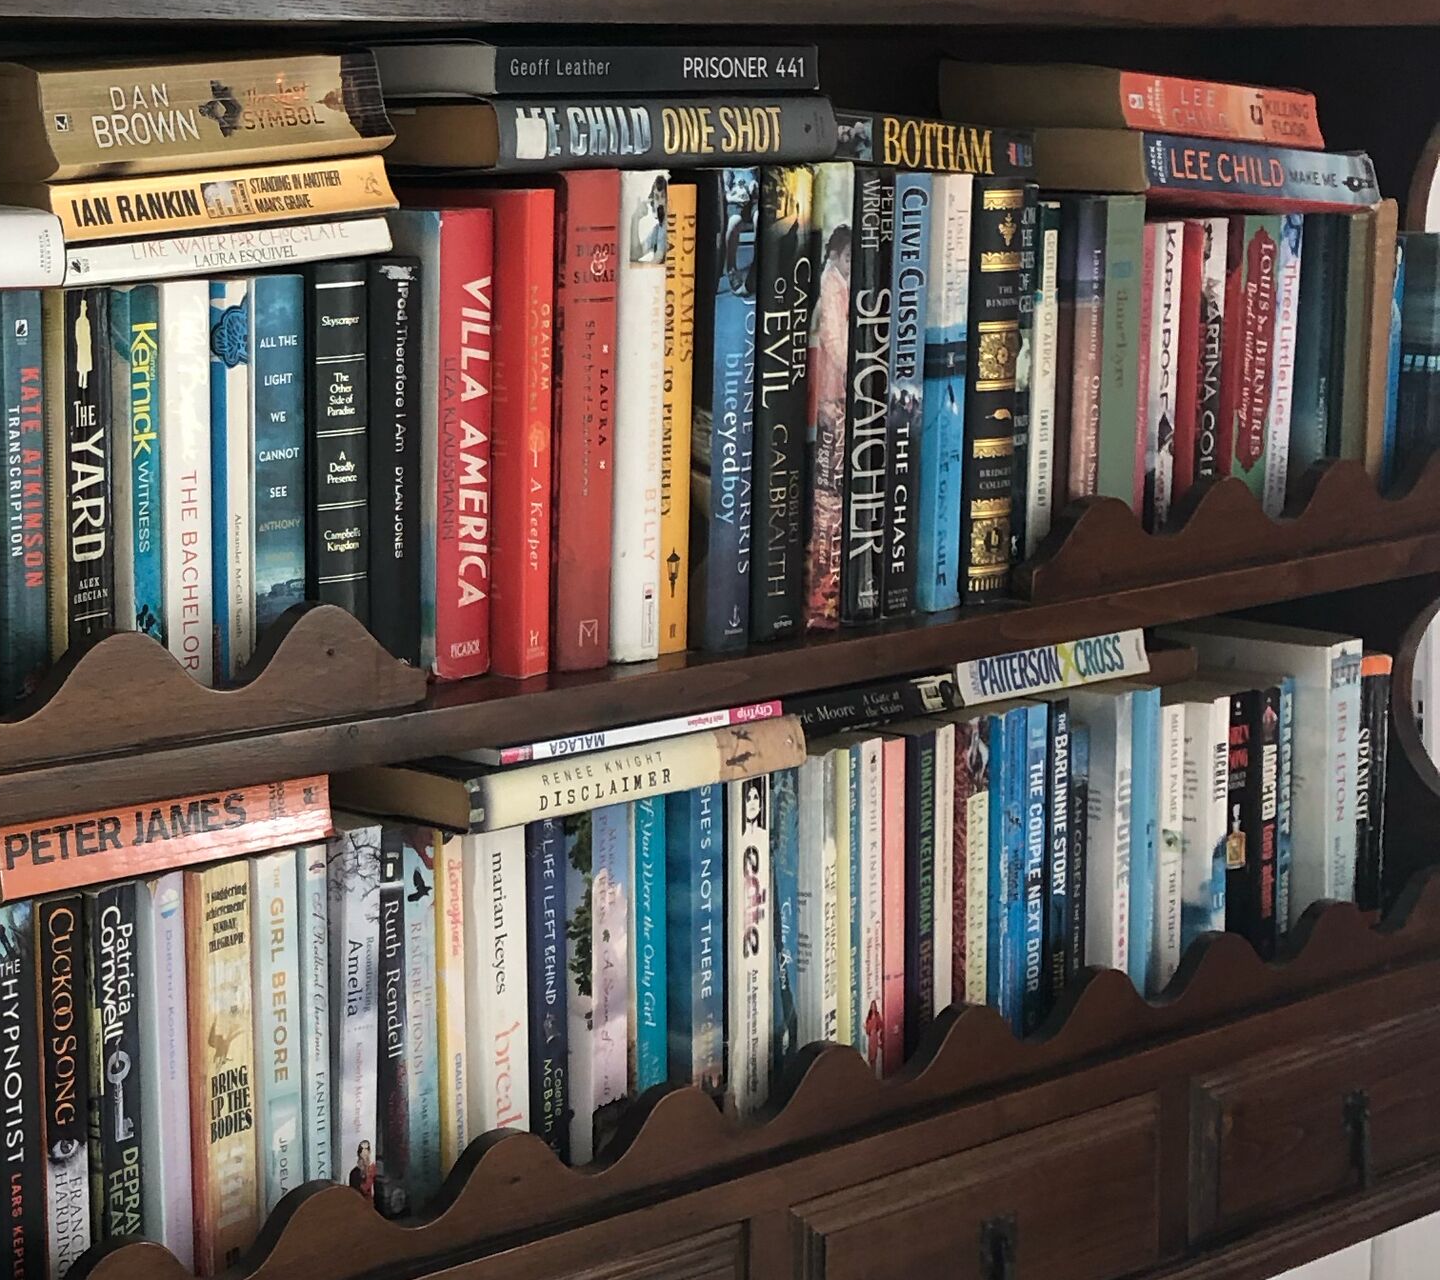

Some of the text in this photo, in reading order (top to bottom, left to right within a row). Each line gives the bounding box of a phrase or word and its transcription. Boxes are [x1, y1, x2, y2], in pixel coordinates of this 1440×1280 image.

[510, 58, 611, 76] Geoff Leather
[682, 56, 806, 79] PRISONER 441
[109, 82, 170, 112] DAN
[91, 110, 200, 149] BROWN
[566, 106, 783, 157] CHILD ONE SHOT
[882, 116, 994, 175] BOTHAM
[250, 170, 342, 195] STANDING IN ANOTHER
[1170, 147, 1286, 188] LEE CHILD
[70, 189, 202, 228] IAN RANKIN
[254, 193, 313, 214] MAN'S GRAVE
[194, 245, 298, 269] LAURA ESQUIVEL
[895, 185, 930, 382] CLIVE CUSSLER
[260, 334, 298, 349] ALL THE
[763, 279, 790, 410] OF EVIL
[791, 256, 812, 384] CAREER
[130, 320, 159, 460] Kernick
[264, 372, 293, 387] LIGHT
[72, 401, 97, 428] THE
[270, 410, 287, 424] WE
[715, 352, 744, 524] blueeyedboy
[258, 447, 300, 462] CANNOT
[457, 276, 491, 610] VILLA AMERICA
[8, 404, 23, 558] TRANSCRIPTION
[19, 365, 44, 589] KATE ATKINSON
[70, 428, 106, 564] YARD
[180, 469, 198, 522] THE
[269, 485, 288, 499] SEE
[890, 422, 910, 575] THE CHASE
[135, 460, 151, 554] WITNESS
[767, 422, 788, 599] GALBRAITH
[180, 529, 200, 673] BACHELOR
[978, 649, 1060, 696] PATTERSON
[1074, 634, 1126, 678] CROSS
[541, 751, 665, 785] RENEE KNIGHT
[549, 733, 605, 755] MALAGA
[538, 768, 672, 812] DISCLAIMER
[1052, 710, 1069, 898] THE BARLINNIE STORY
[3, 791, 248, 871] PETER JAMES
[699, 783, 712, 1000] SHE'S NOT THERE
[1025, 760, 1045, 994] THE COUPLE NEXT DOOR
[492, 852, 507, 996] marian keyes
[98, 904, 124, 1045] Cornwell
[115, 922, 134, 1015] Patricia
[346, 939, 359, 1019] Amelia
[384, 899, 403, 1059] Ruth Rendell
[48, 906, 76, 1128] CUCKOO SONG
[1, 974, 26, 1165] HYPNOTIST
[211, 1065, 250, 1097] BRING
[211, 1090, 252, 1121] UP THE
[211, 1108, 253, 1144] BODIES
